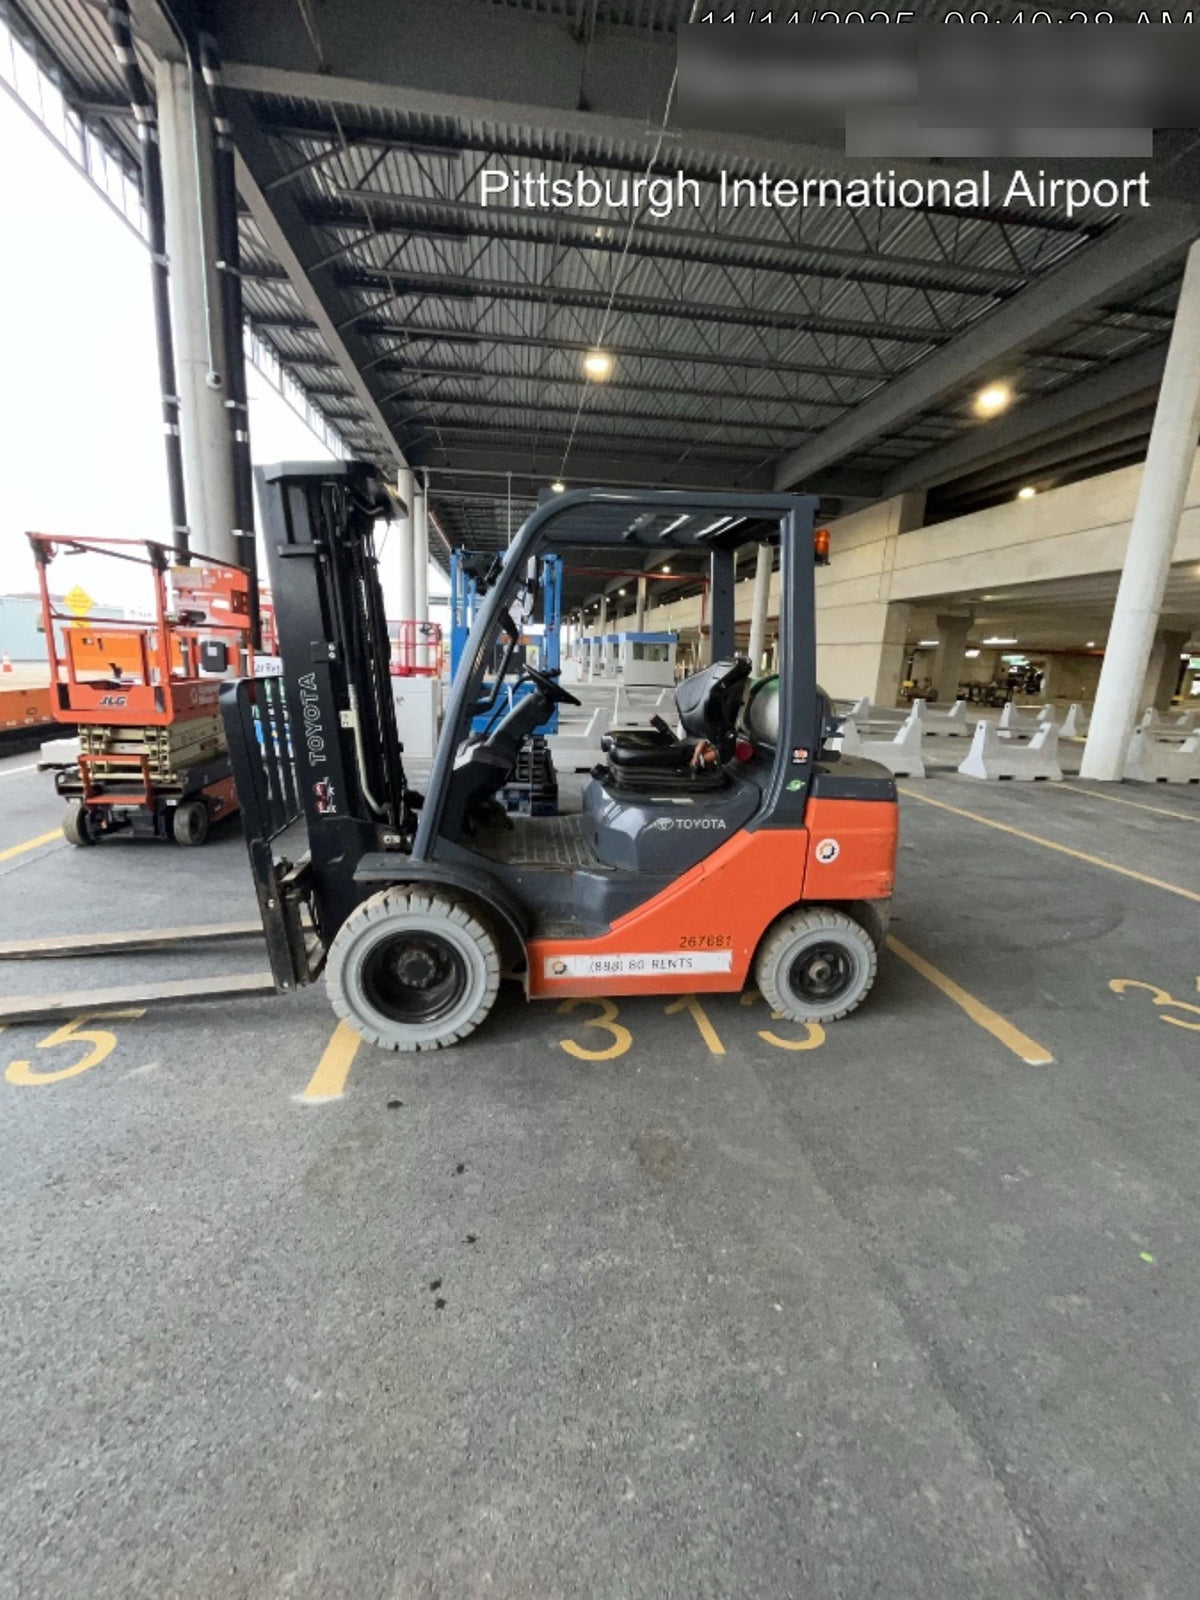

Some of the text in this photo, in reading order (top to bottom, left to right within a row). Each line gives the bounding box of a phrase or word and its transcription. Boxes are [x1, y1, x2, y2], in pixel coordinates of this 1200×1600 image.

[97, 694, 128, 707] JLG
[299, 672, 327, 767] TOYOTA
[675, 818, 727, 830] TOYOTA
[651, 957, 693, 970] RENTS
